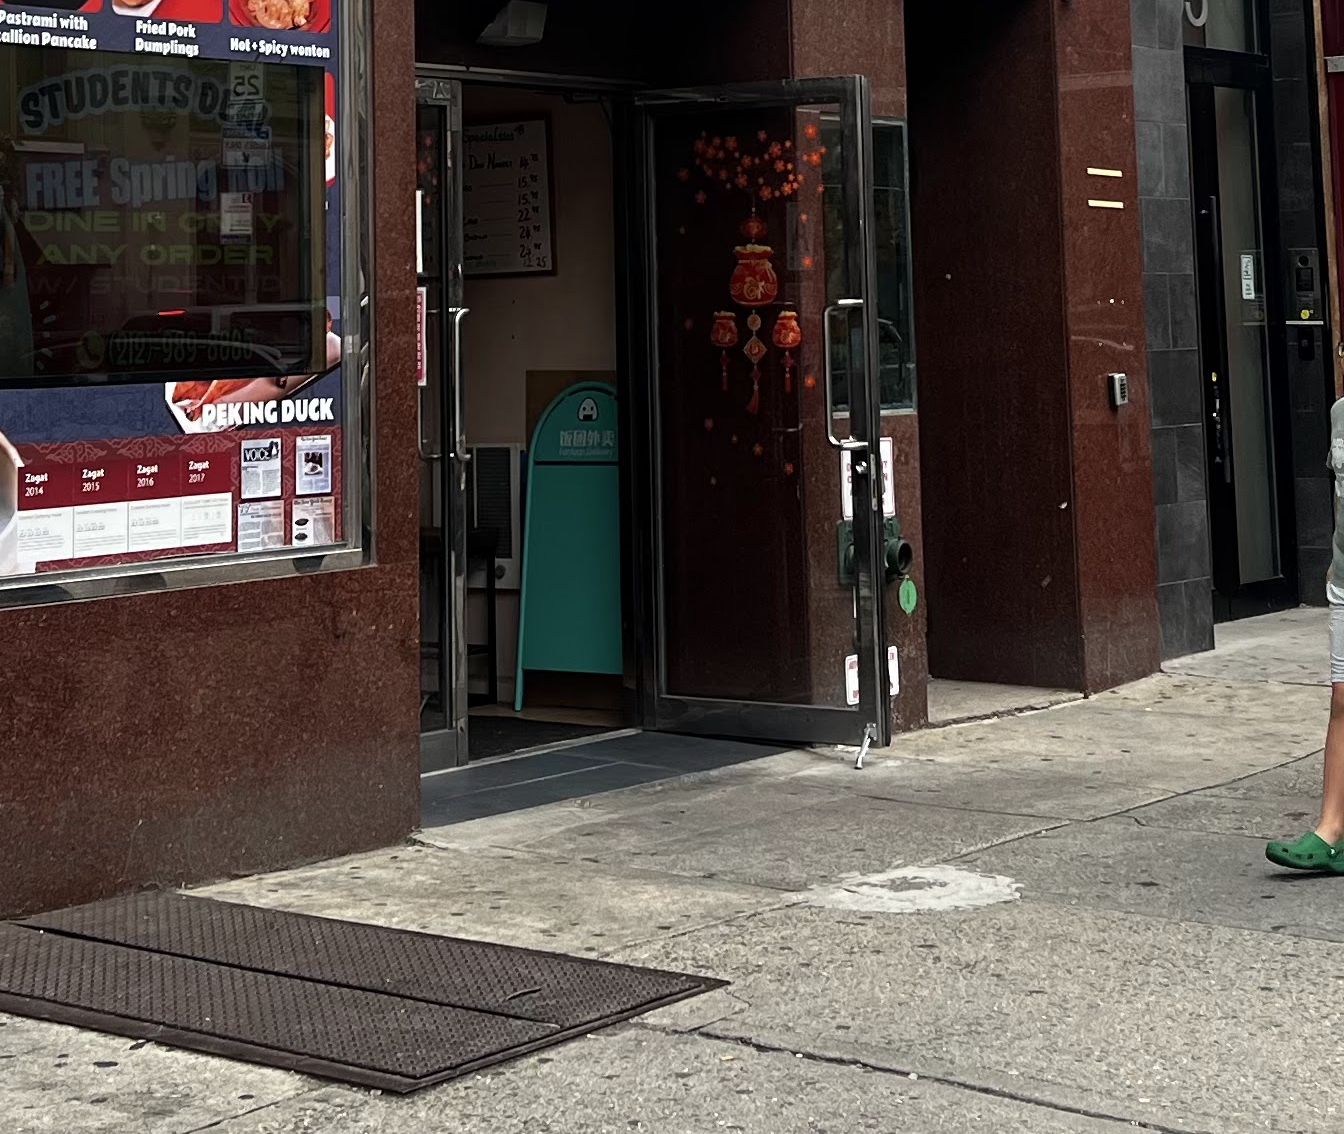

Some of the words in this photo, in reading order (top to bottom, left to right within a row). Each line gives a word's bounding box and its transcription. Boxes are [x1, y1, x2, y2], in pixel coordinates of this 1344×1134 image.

[59, 14, 88, 31] with
[135, 20, 167, 36] Fried
[168, 23, 196, 38] Pork
[41, 34, 97, 50] Pancake
[135, 38, 199, 57] Dumplings
[230, 37, 251, 52] Hot
[258, 39, 289, 57] Spicy
[289, 44, 331, 58] wonton
[21, 70, 192, 129] STUDENTS
[25, 159, 102, 210] FREE
[109, 154, 216, 207] Spring
[141, 242, 273, 265] ORDER
[202, 398, 277, 427] PEKING
[281, 397, 335, 423] DUCK
[25, 472, 48, 484] Zagat
[82, 468, 105, 479] Zagat
[136, 464, 158, 475] Zagat
[188, 460, 210, 470] Zagat
[24, 486, 44, 497] 2014
[82, 482, 100, 492] 2015
[136, 477, 154, 488] 2016
[188, 472, 206, 484] 2017
